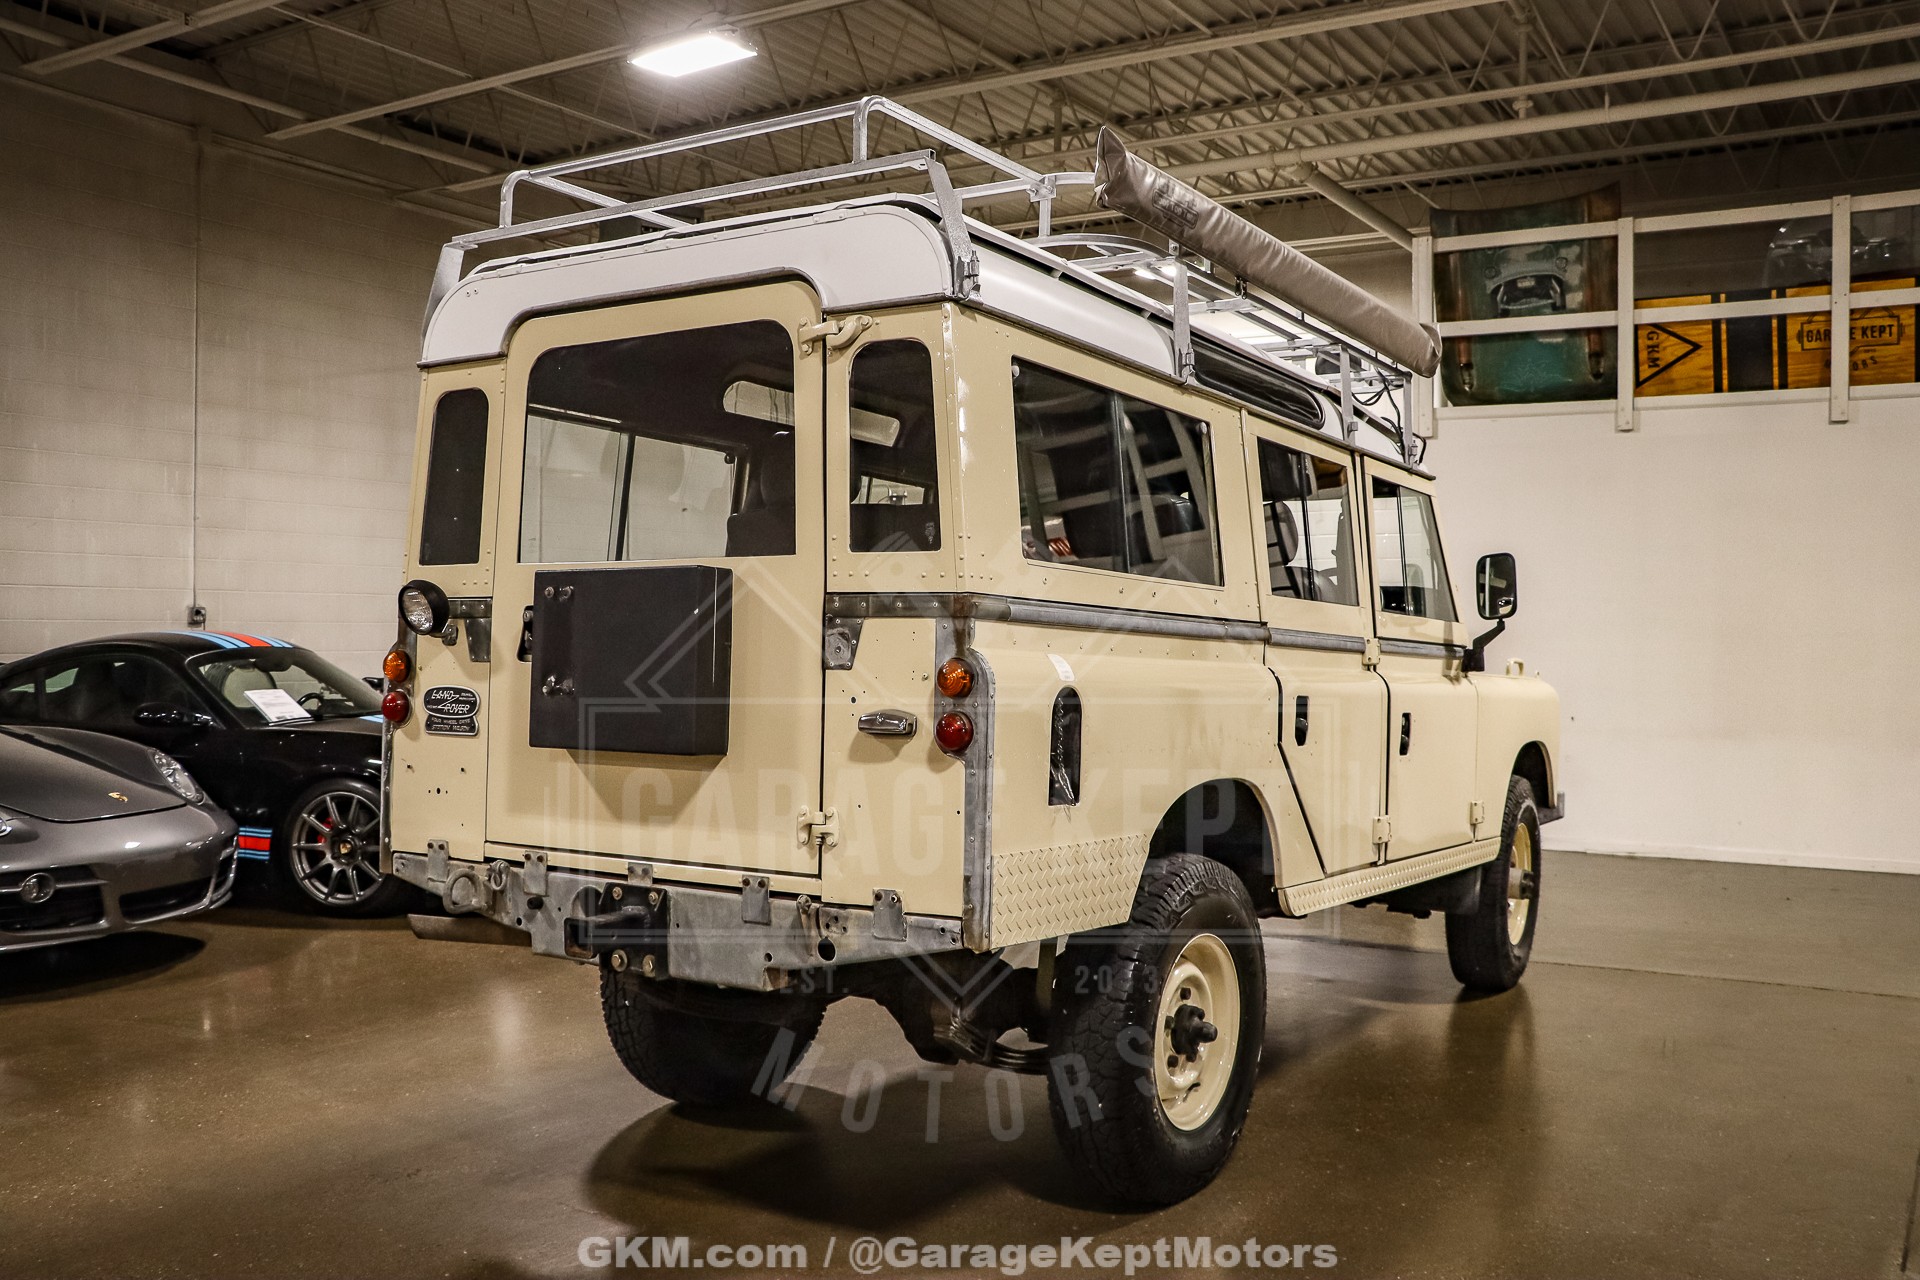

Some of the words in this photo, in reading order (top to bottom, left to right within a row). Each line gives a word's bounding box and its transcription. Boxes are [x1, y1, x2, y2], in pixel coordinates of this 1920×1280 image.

[1806, 328, 1856, 343] GARE
[1861, 324, 1894, 340] KEPT
[1647, 331, 1661, 368] GKM
[431, 690, 454, 700] LAND
[444, 704, 470, 713] ROVER
